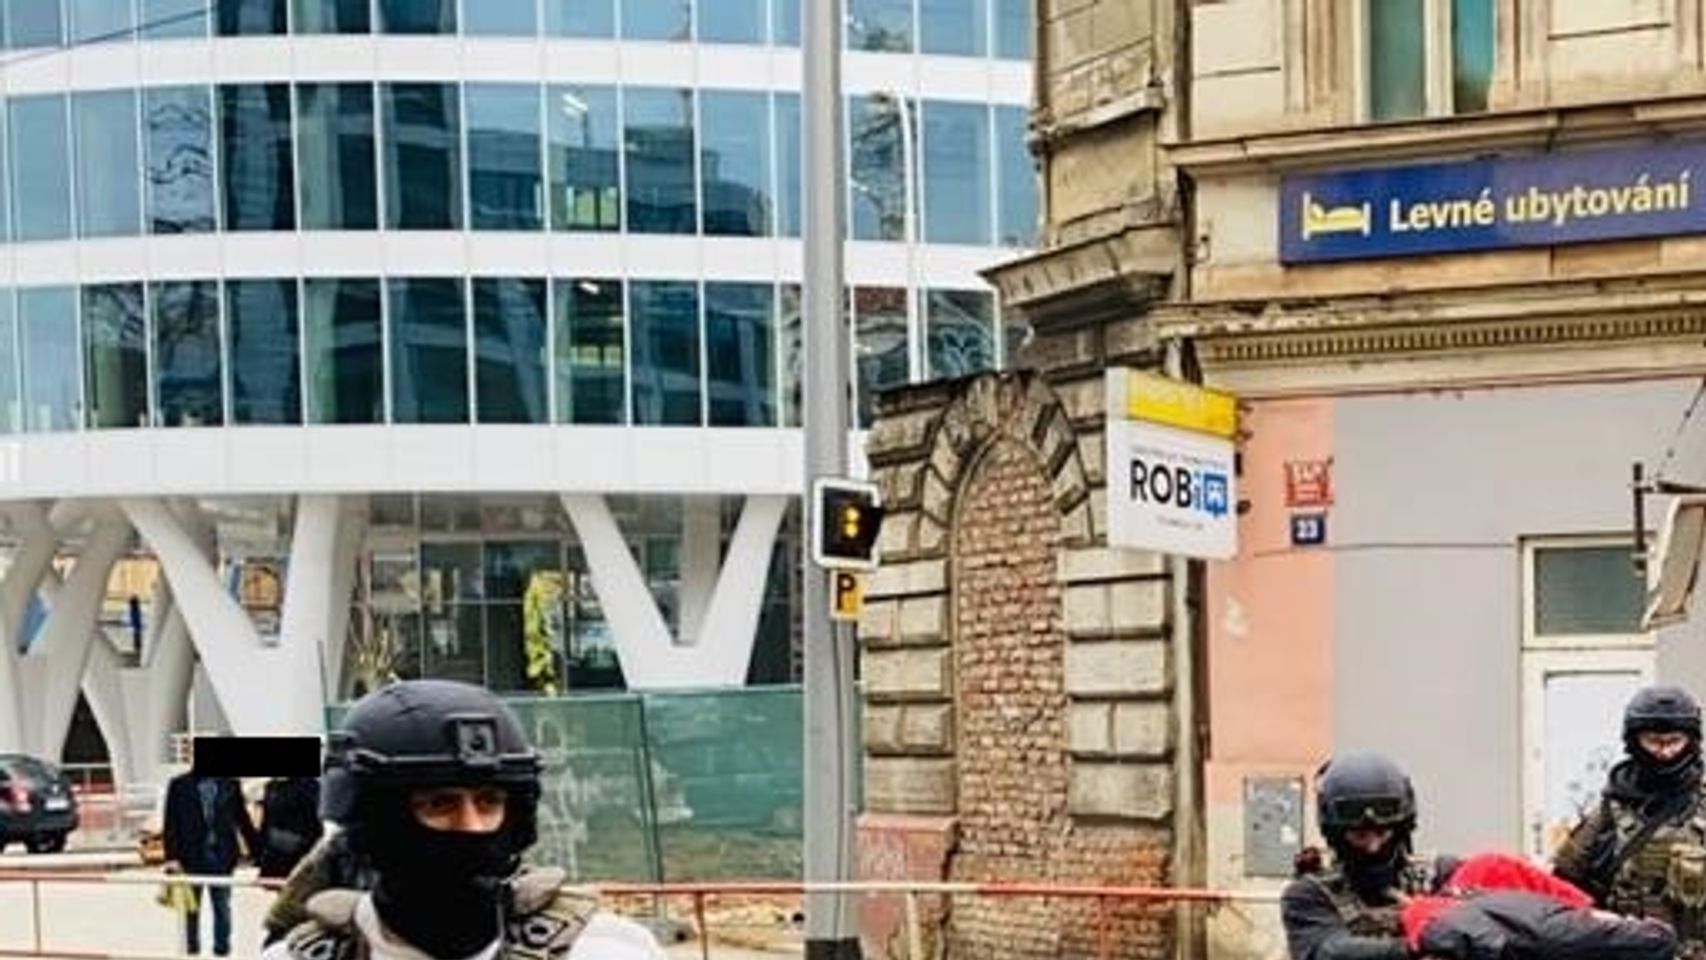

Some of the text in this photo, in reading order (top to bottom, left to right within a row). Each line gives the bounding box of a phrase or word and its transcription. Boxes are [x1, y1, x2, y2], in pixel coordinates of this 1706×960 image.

[1389, 169, 1692, 232] Levné ubytování
[836, 573, 857, 611] P
